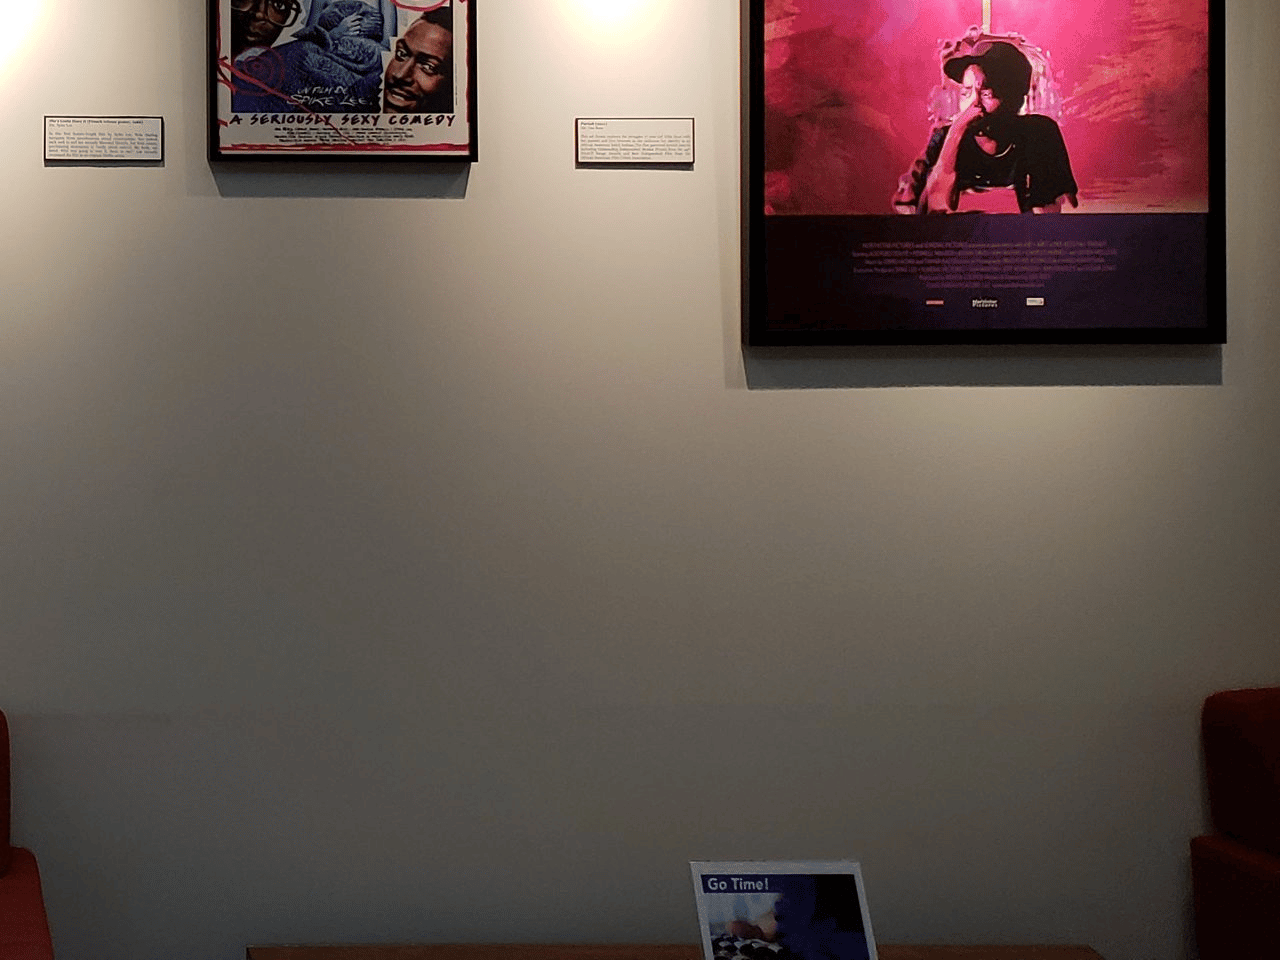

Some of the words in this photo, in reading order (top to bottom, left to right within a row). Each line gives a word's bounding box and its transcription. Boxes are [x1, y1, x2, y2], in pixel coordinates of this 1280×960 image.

[286, 94, 334, 107] SPIKE
[229, 115, 243, 125] A
[250, 114, 333, 127] SERIOUSLY
[341, 114, 381, 127] SEXY
[388, 114, 456, 127] COMEDY
[707, 877, 728, 891] Go
[731, 877, 769, 891] Time!
